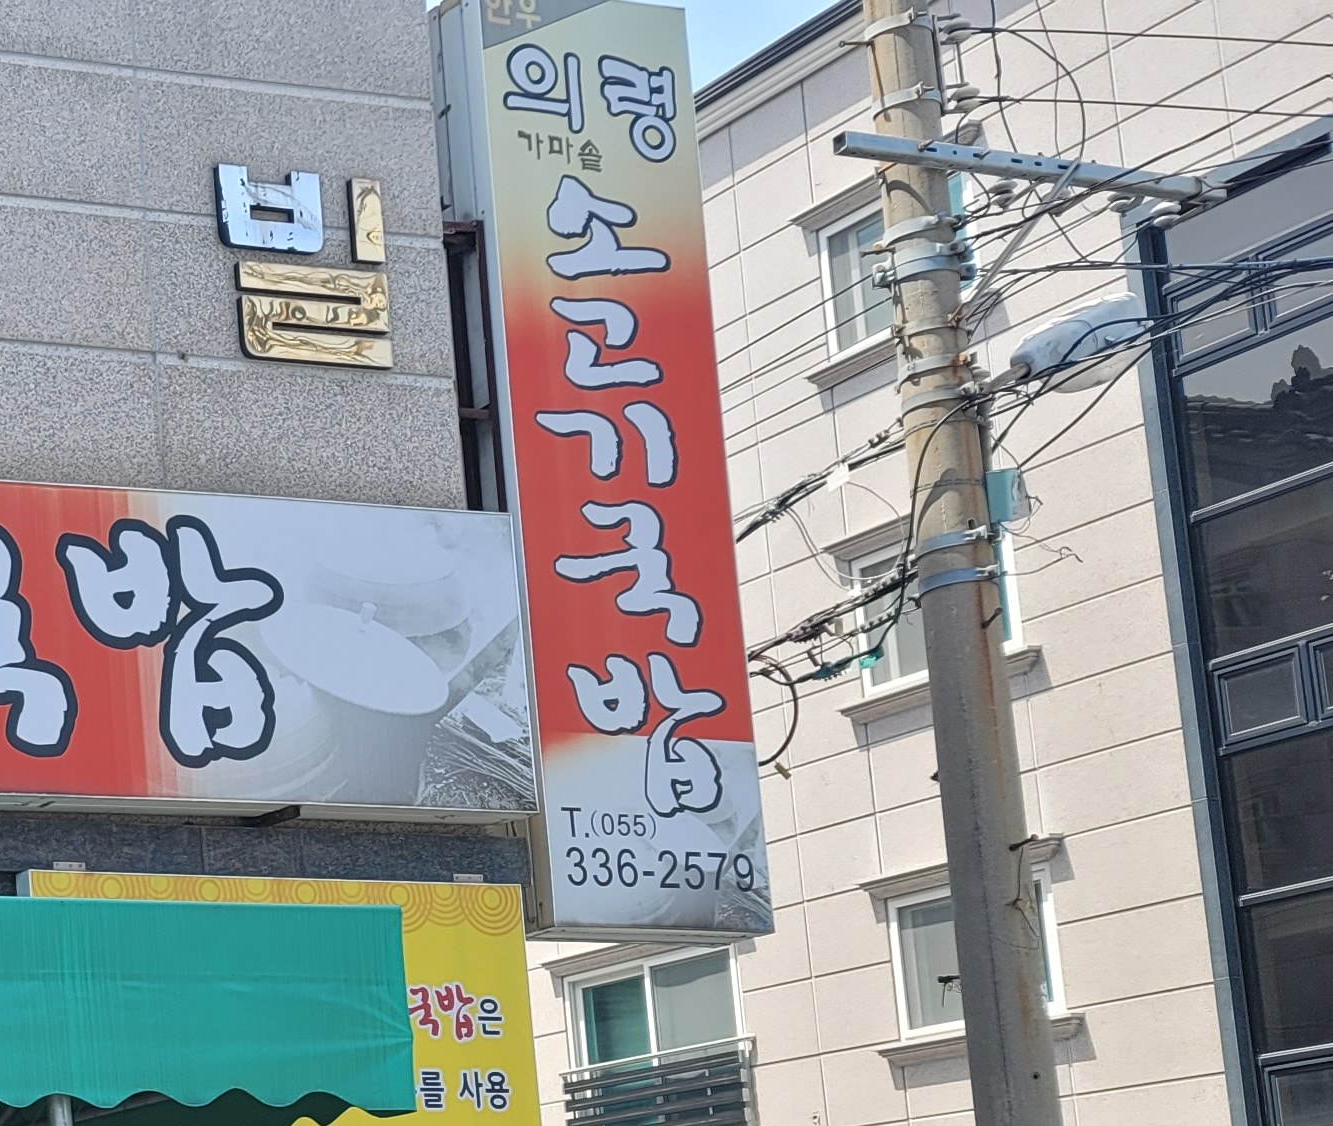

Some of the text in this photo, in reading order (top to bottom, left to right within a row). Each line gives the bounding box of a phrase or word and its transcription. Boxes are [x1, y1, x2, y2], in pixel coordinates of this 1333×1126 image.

[503, 43, 676, 163] 의령
[517, 130, 603, 172] 가마솥
[566, 846, 755, 893] 336-2579
[415, 1071, 509, 1109] 를 사용
